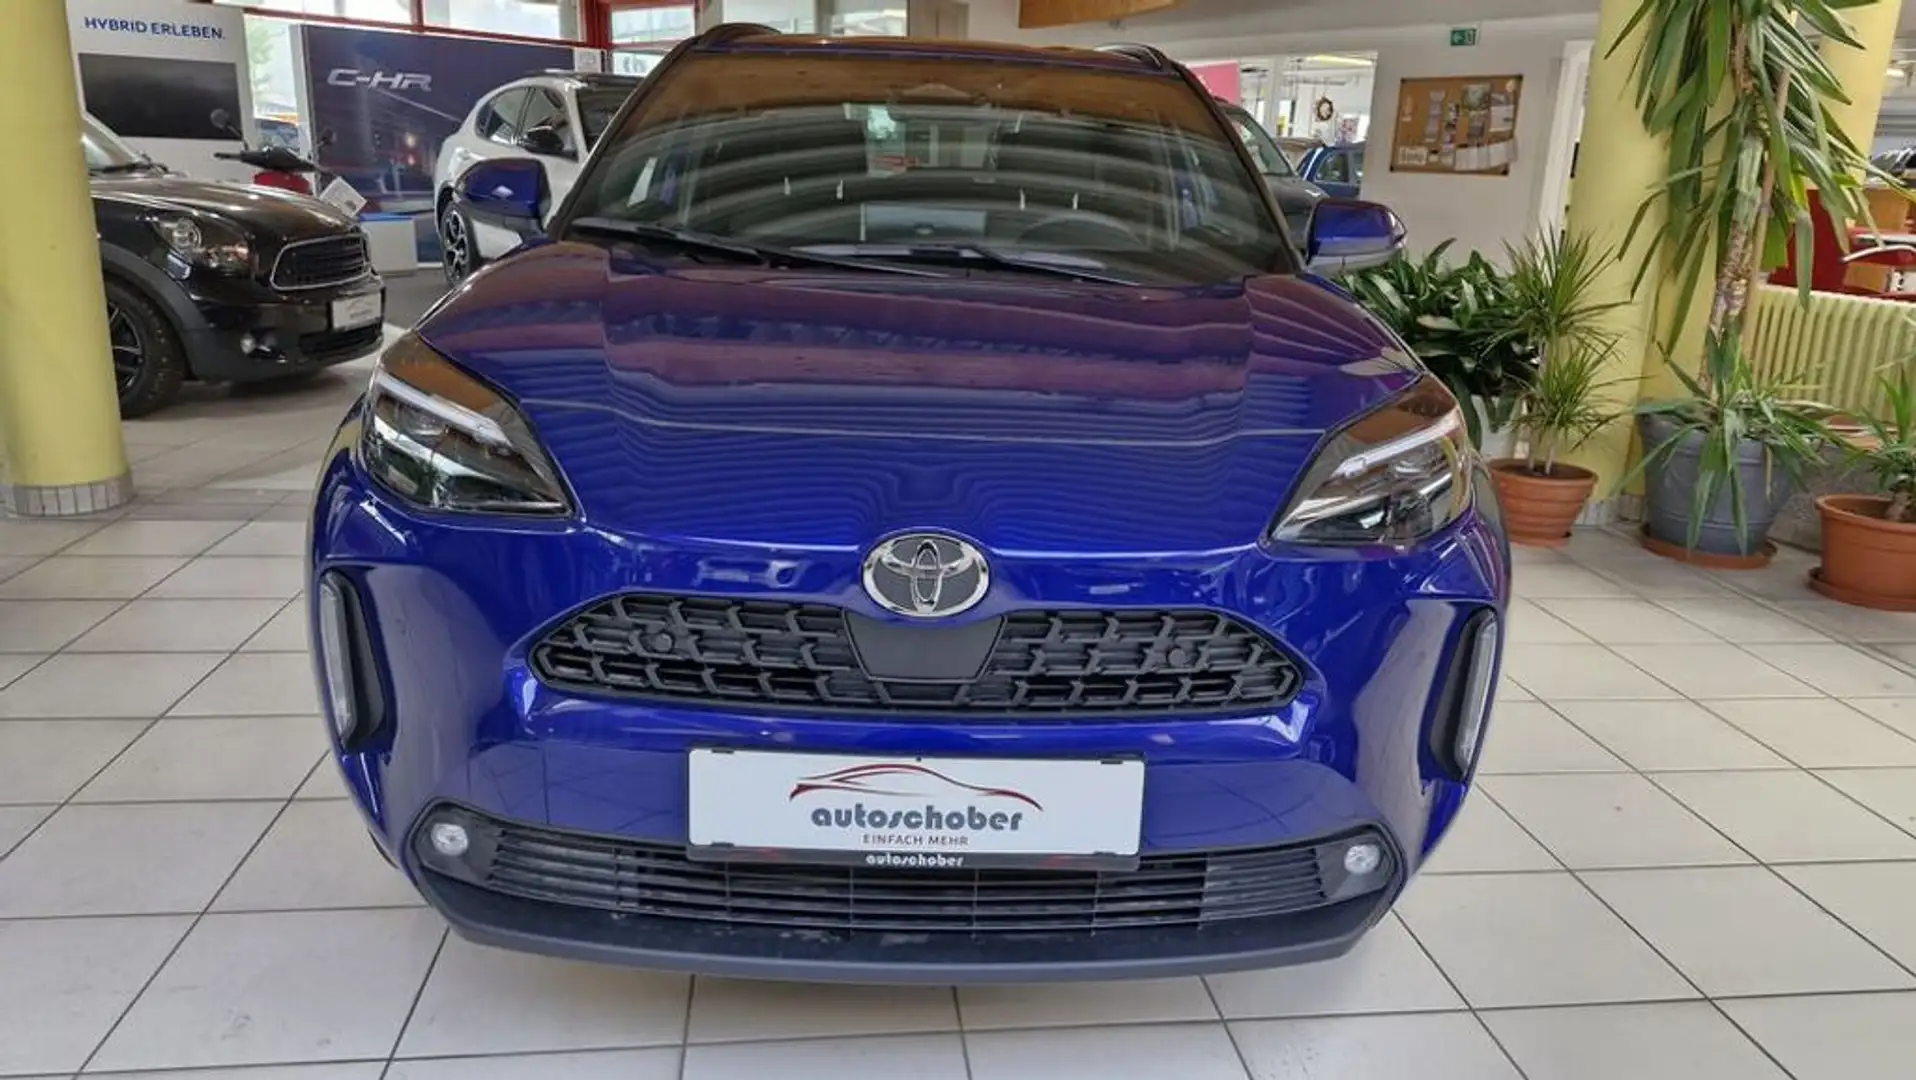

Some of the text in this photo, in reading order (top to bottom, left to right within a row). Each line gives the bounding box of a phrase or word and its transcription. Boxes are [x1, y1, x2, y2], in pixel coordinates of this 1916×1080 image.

[84, 16, 226, 39] HYBRID ERLEBEN.
[327, 68, 432, 92] C-HR
[811, 803, 1023, 831] autoschober
[862, 833, 969, 846] EINFACH MEHR
[865, 852, 965, 868] autoschober
